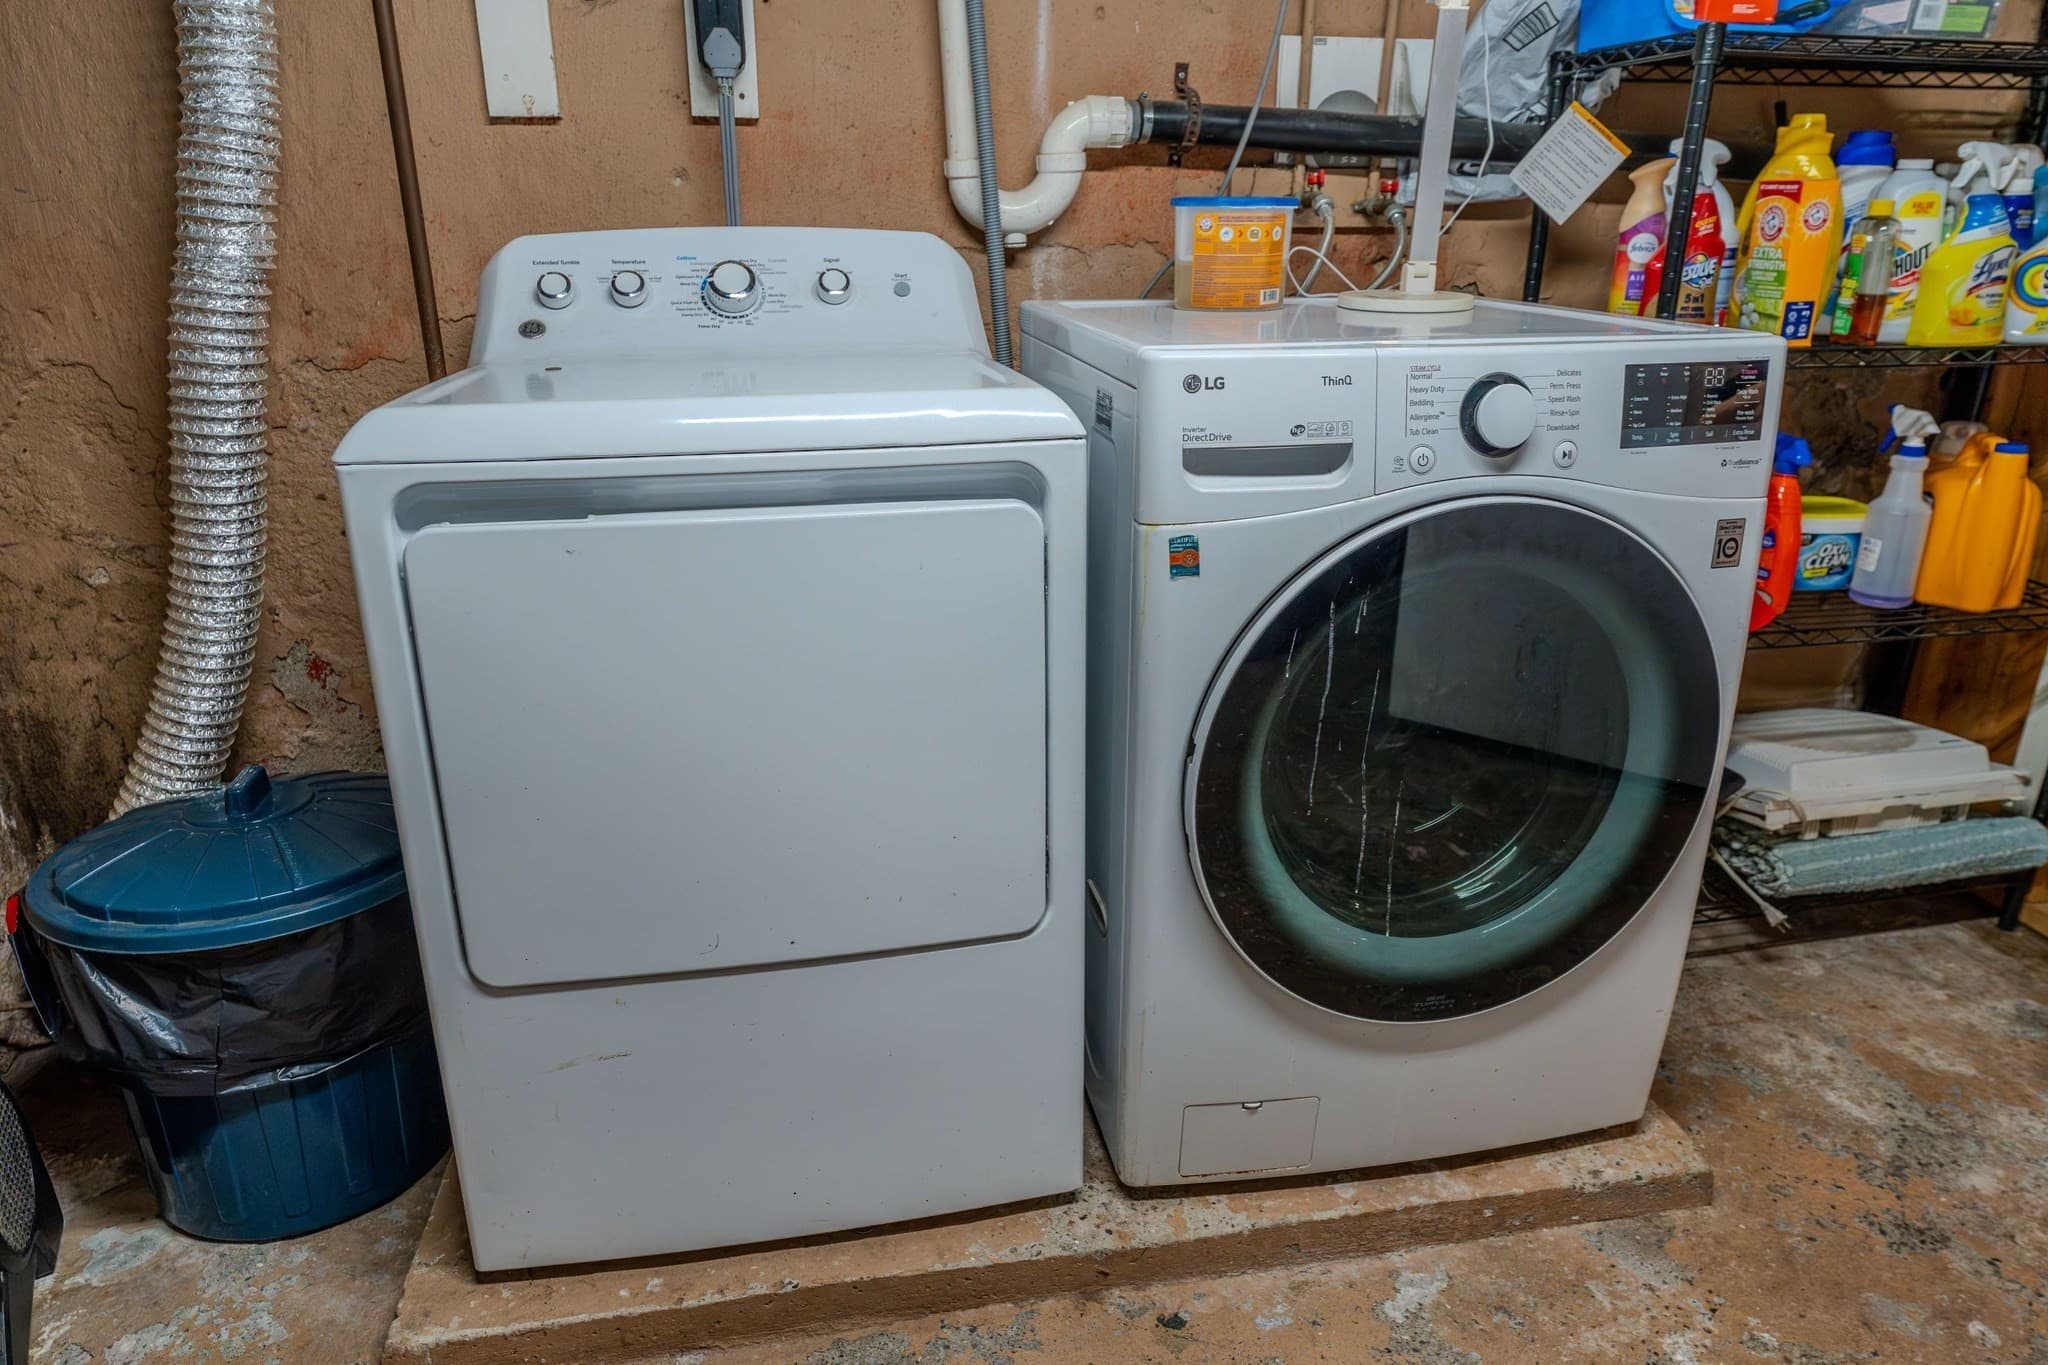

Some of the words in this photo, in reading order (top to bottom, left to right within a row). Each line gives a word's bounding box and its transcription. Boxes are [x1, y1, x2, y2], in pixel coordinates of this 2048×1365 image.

[1753, 248, 1782, 259] EXTRA
[1895, 242, 1932, 277] HOUT
[1973, 249, 2013, 281] Lysol
[1681, 258, 1718, 280] ESOLVE
[1685, 294, 1692, 304] 5
[1410, 372, 1433, 380] Normal
[1557, 369, 1582, 377] Delicates
[1204, 376, 1225, 391] LG
[1321, 375, 1352, 387] ThinQ
[1410, 385, 1429, 395] Heavy
[1430, 385, 1446, 395] Duty
[1410, 399, 1435, 408] Bedding
[1547, 396, 1565, 404] Speed
[1549, 409, 1580, 417] Rinse+Spin
[1409, 428, 1421, 436] Tub
[1421, 427, 1439, 435] Clean
[1716, 537, 1740, 559] 10
[1820, 543, 1848, 556] OXI
[1806, 553, 1850, 569] CLEAN
